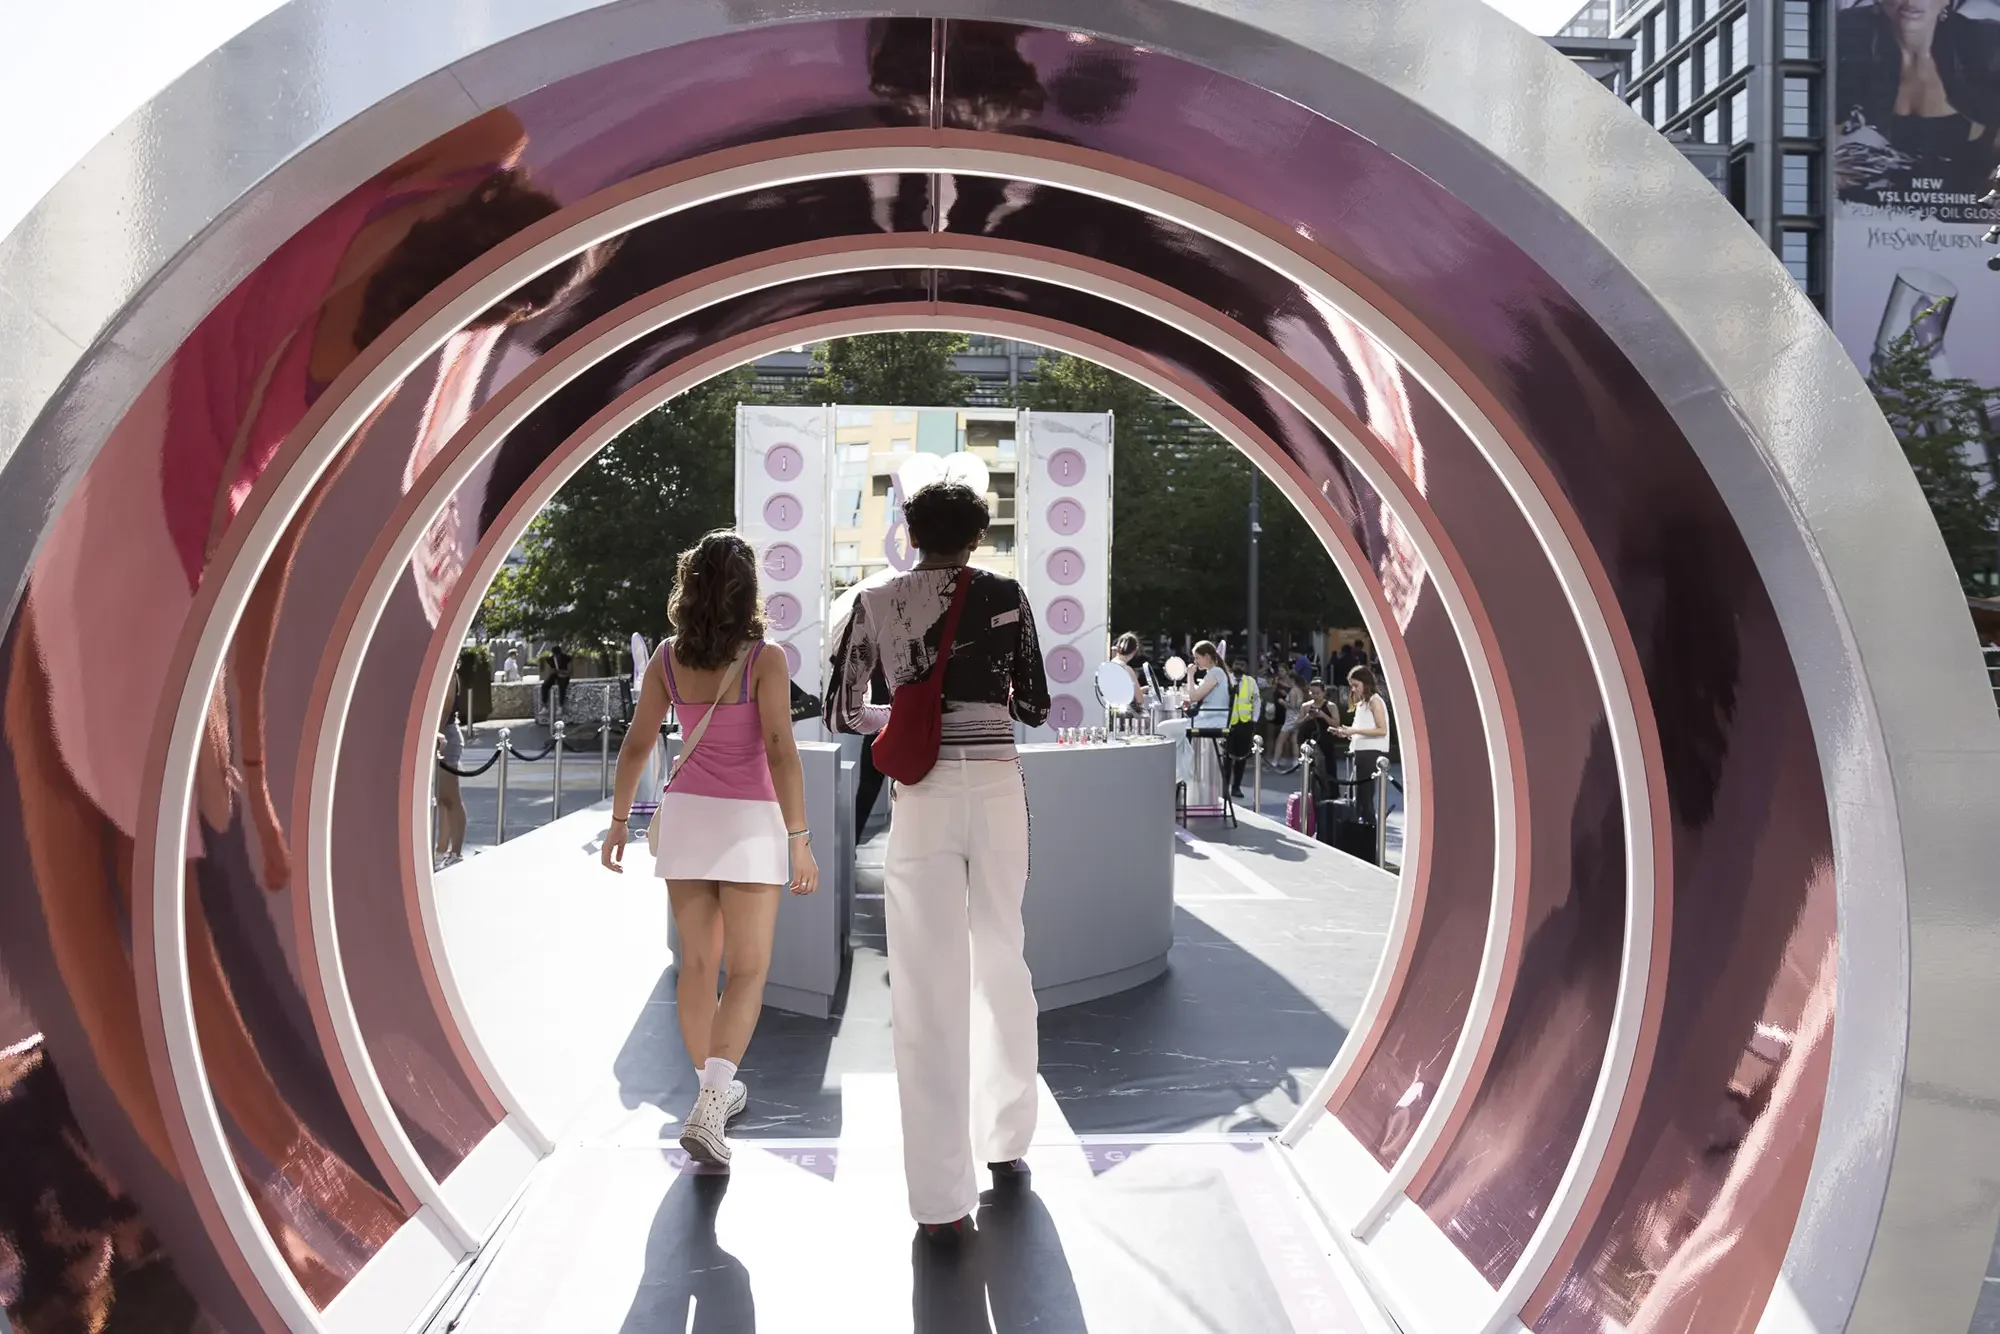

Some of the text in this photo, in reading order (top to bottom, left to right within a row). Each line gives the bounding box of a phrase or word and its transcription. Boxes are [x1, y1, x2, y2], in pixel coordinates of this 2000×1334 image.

[1911, 178, 1943, 189] NEW
[1877, 191, 1977, 204] YSL LOVESHINE
[1941, 206, 1961, 218] OIL
